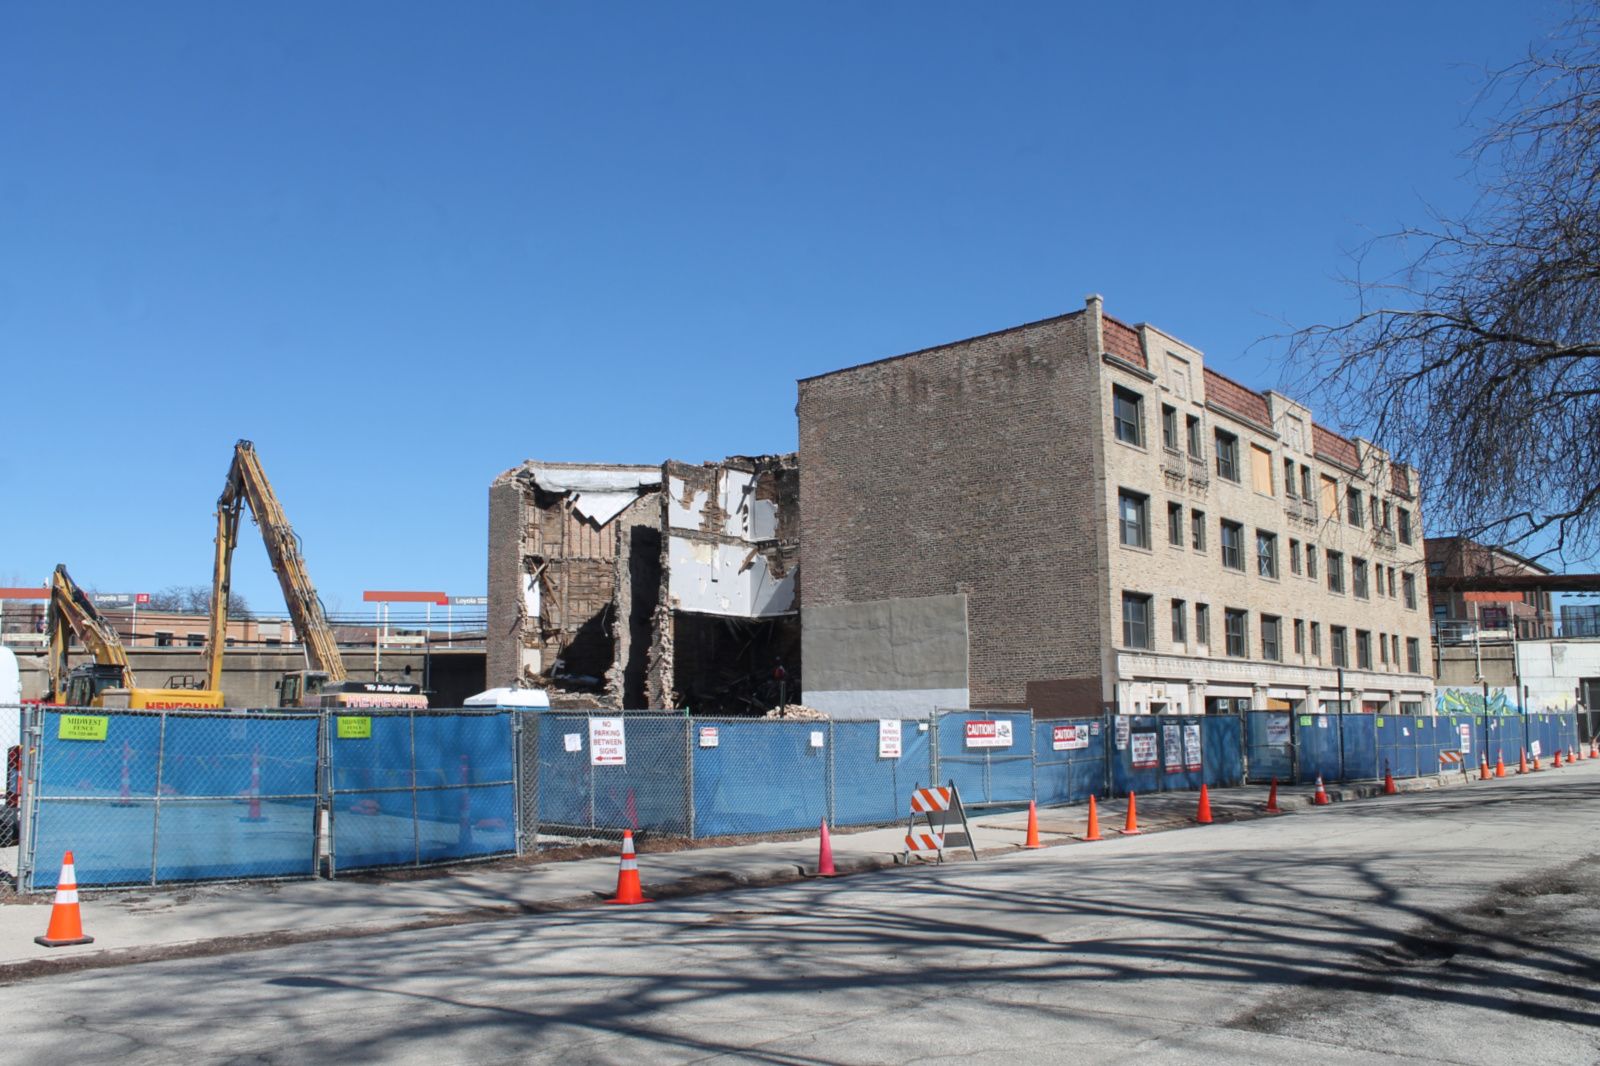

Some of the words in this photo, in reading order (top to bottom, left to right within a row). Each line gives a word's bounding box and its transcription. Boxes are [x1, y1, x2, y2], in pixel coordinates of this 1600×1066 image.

[95, 594, 117, 602] Loyola
[455, 597, 477, 605] Loyola
[67, 717, 102, 726] MIDWEST
[602, 720, 612, 728] NO
[594, 729, 620, 737] PARKING
[593, 738, 622, 746] BETWEEN
[599, 747, 618, 755] SIGNS
